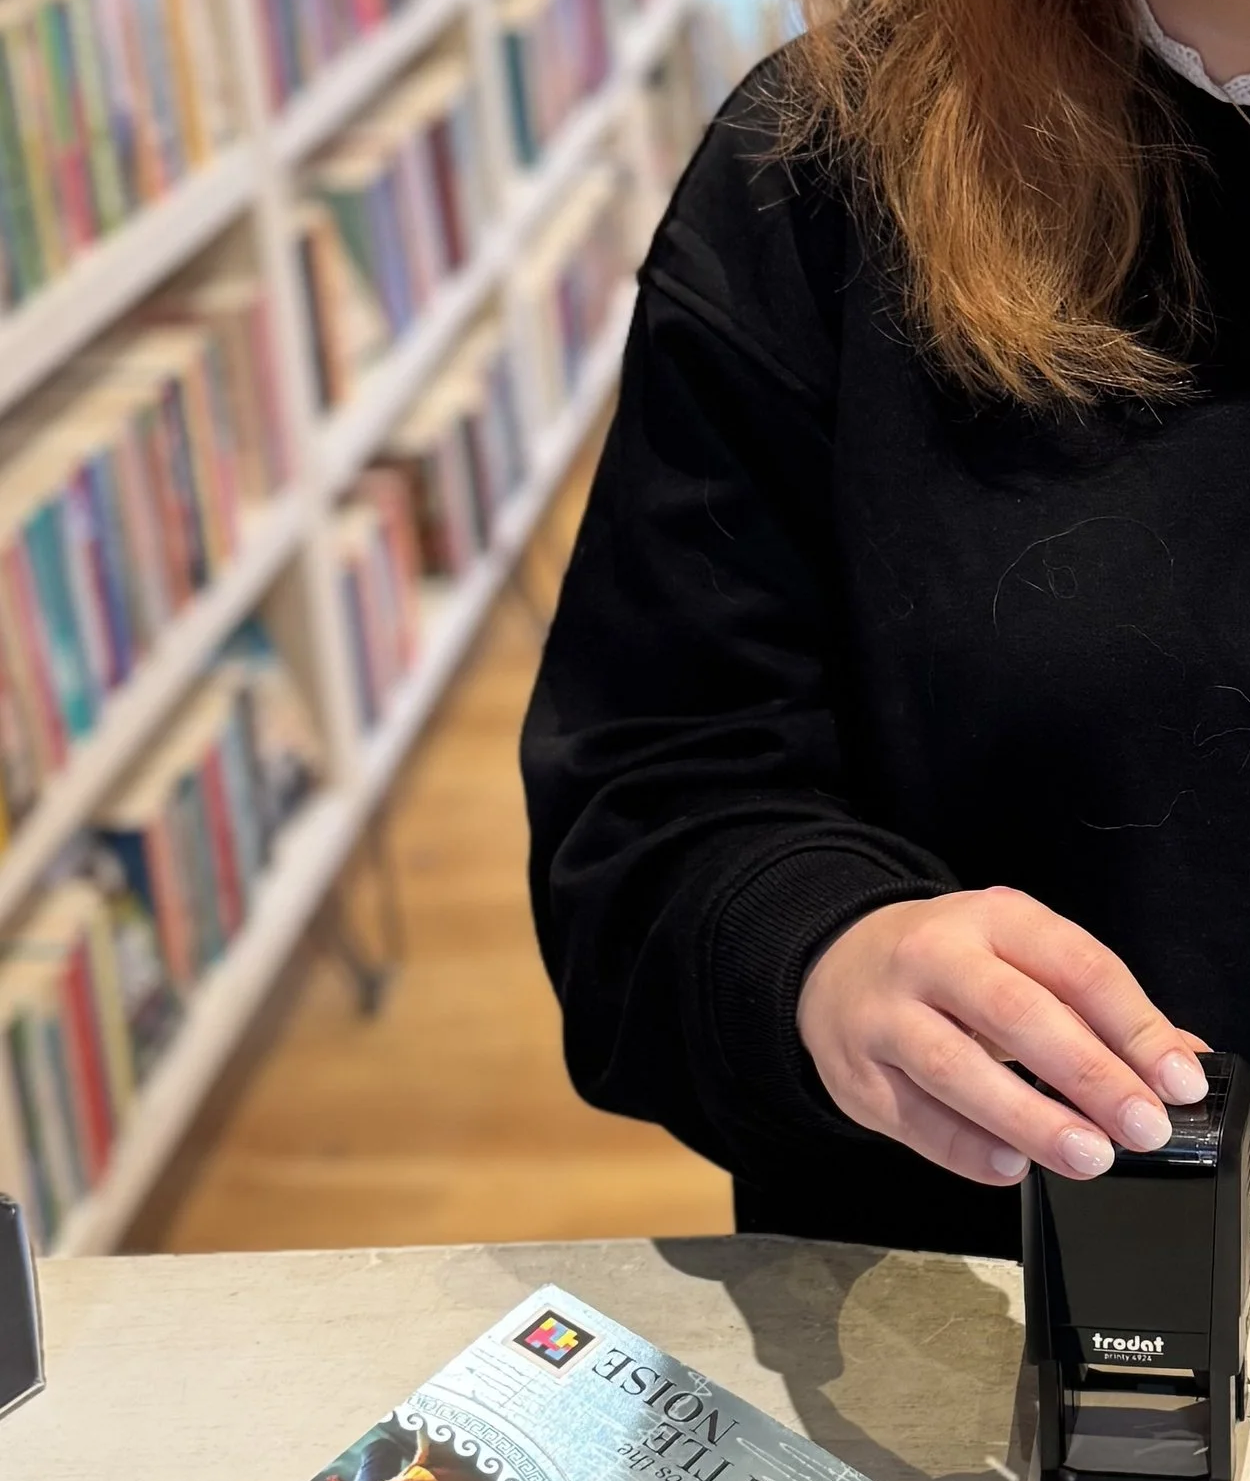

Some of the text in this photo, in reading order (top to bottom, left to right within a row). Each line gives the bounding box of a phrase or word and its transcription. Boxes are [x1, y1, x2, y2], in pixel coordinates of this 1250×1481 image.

[1092, 1332, 1165, 1353] trodat
[1104, 1353, 1152, 1362] printy 4924
[592, 1347, 739, 1447] NOISE
[617, 1443, 655, 1473] the
